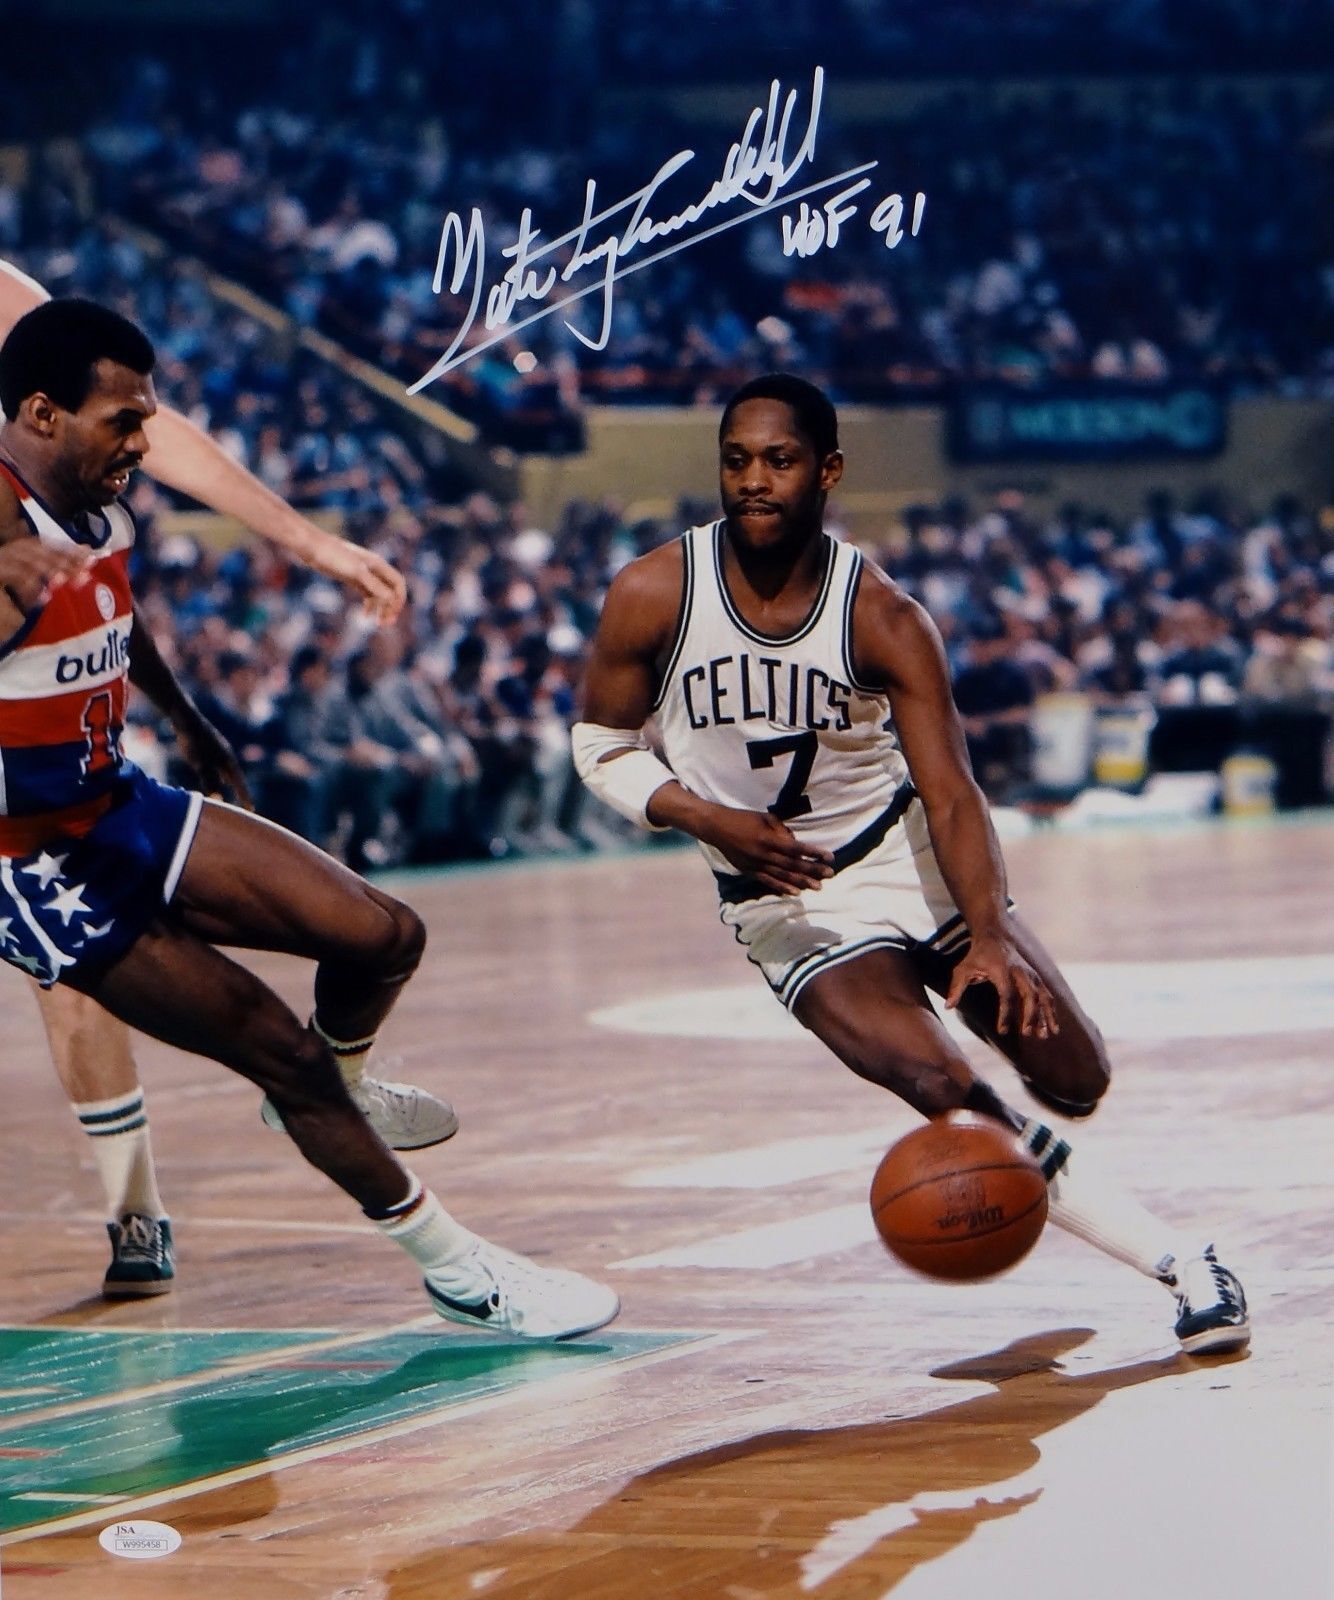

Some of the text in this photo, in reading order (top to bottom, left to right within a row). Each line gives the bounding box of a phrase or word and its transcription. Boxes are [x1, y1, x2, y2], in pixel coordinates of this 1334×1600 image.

[869, 191, 926, 249] 91
[682, 653, 852, 732] CELTICS
[746, 730, 819, 821] 7
[114, 1525, 136, 1536] JSA
[122, 1540, 161, 1550] W995458
